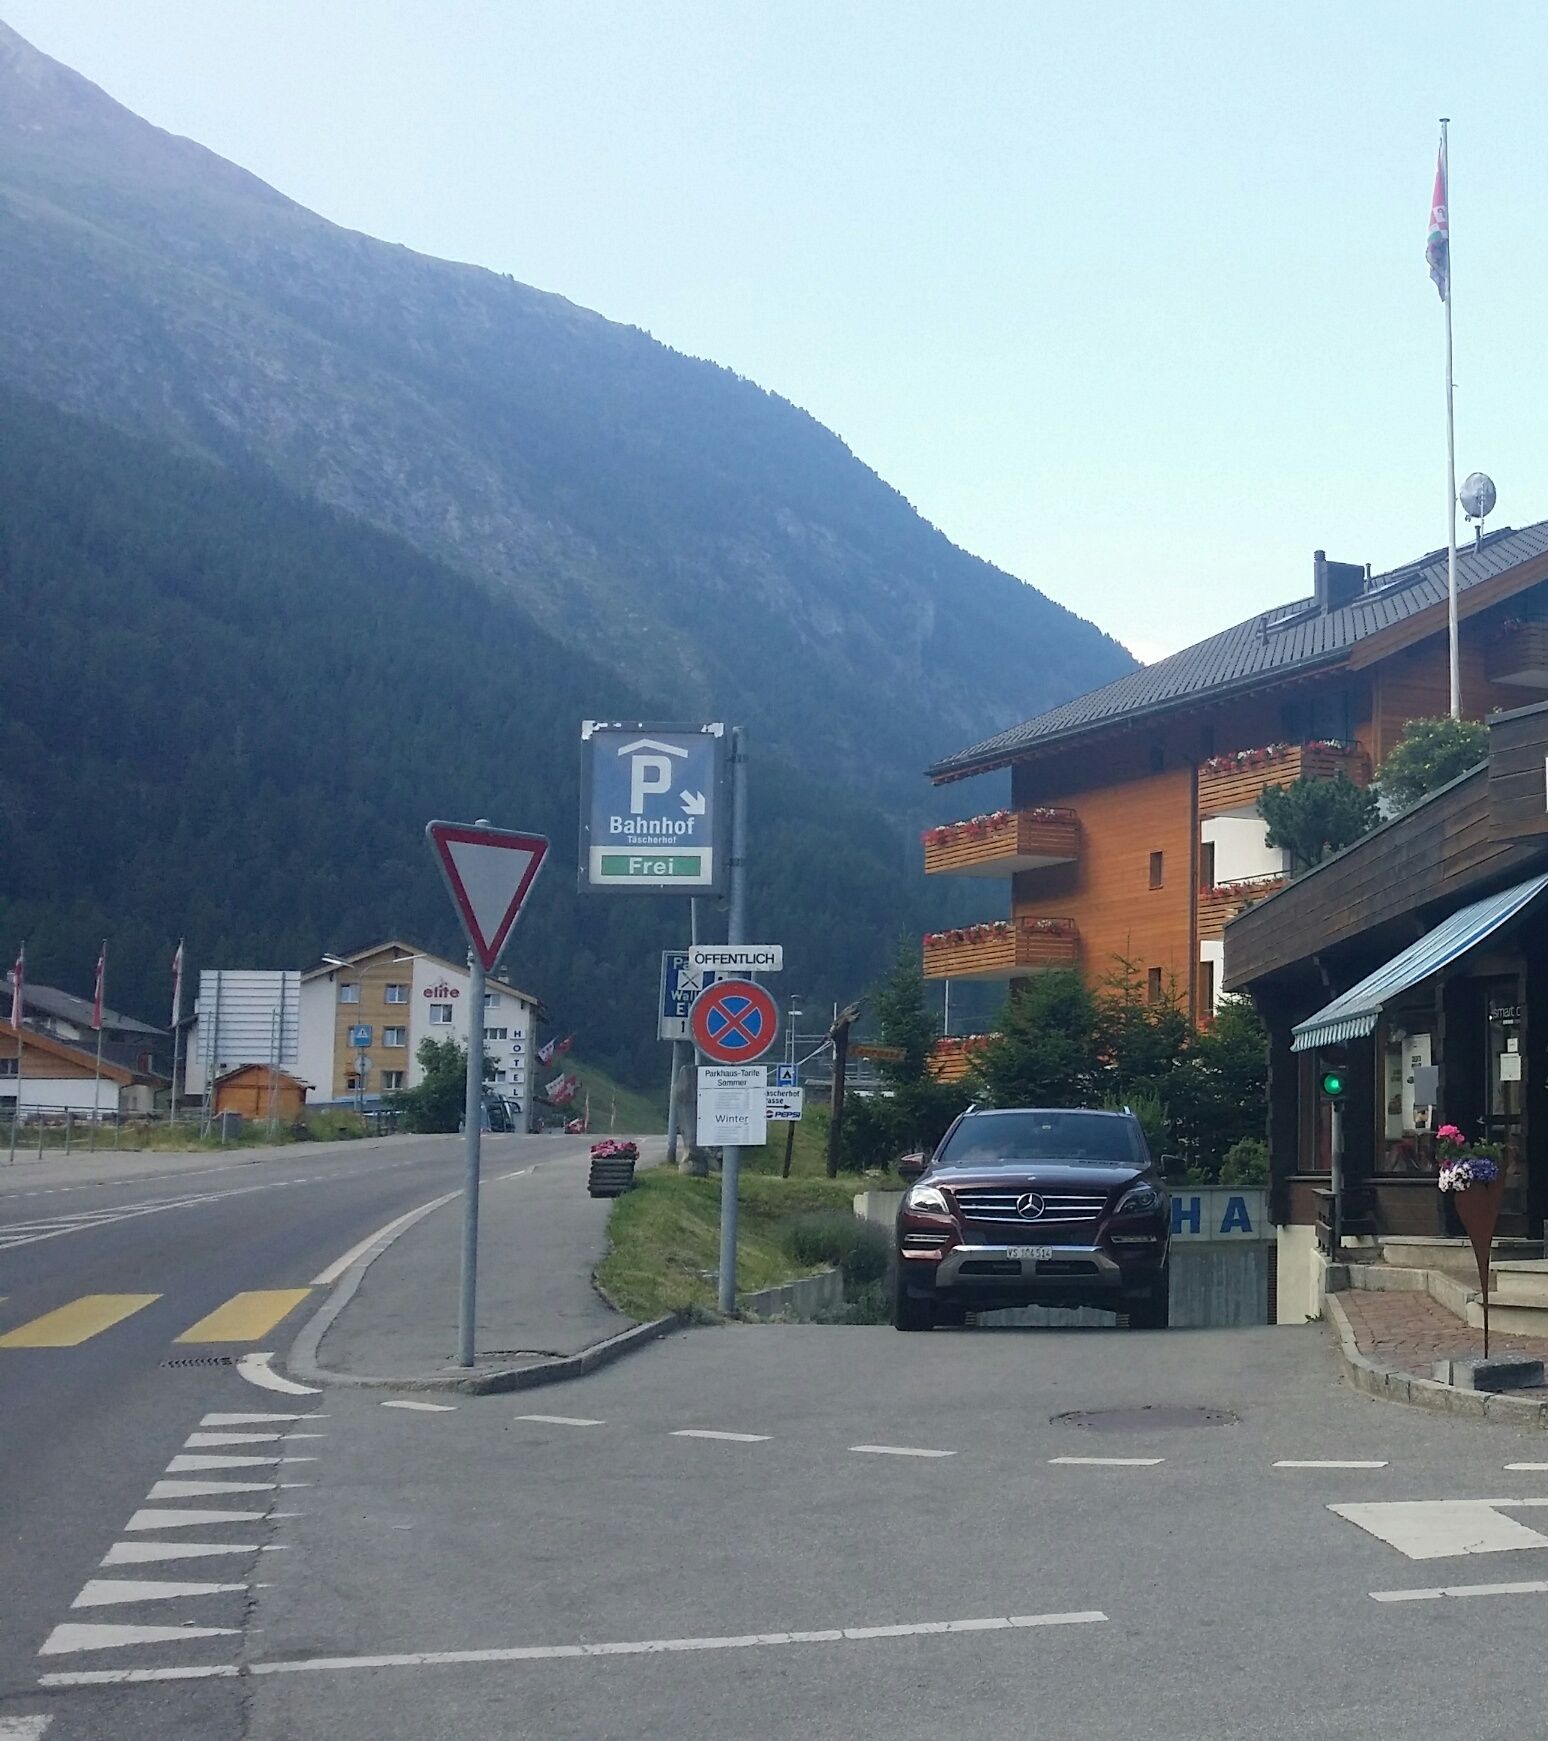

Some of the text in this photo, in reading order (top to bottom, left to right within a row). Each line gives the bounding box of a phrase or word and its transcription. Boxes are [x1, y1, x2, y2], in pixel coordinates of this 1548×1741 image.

[610, 816, 694, 834] Bahnhof
[627, 835, 677, 843] Täscherhof
[629, 857, 674, 874] Frei
[673, 957, 689, 970] Pa
[423, 985, 460, 998] elite
[513, 1030, 522, 1096] HOTEL
[705, 1069, 760, 1077] Parkhaus-Tarife
[715, 1114, 749, 1123] Winter
